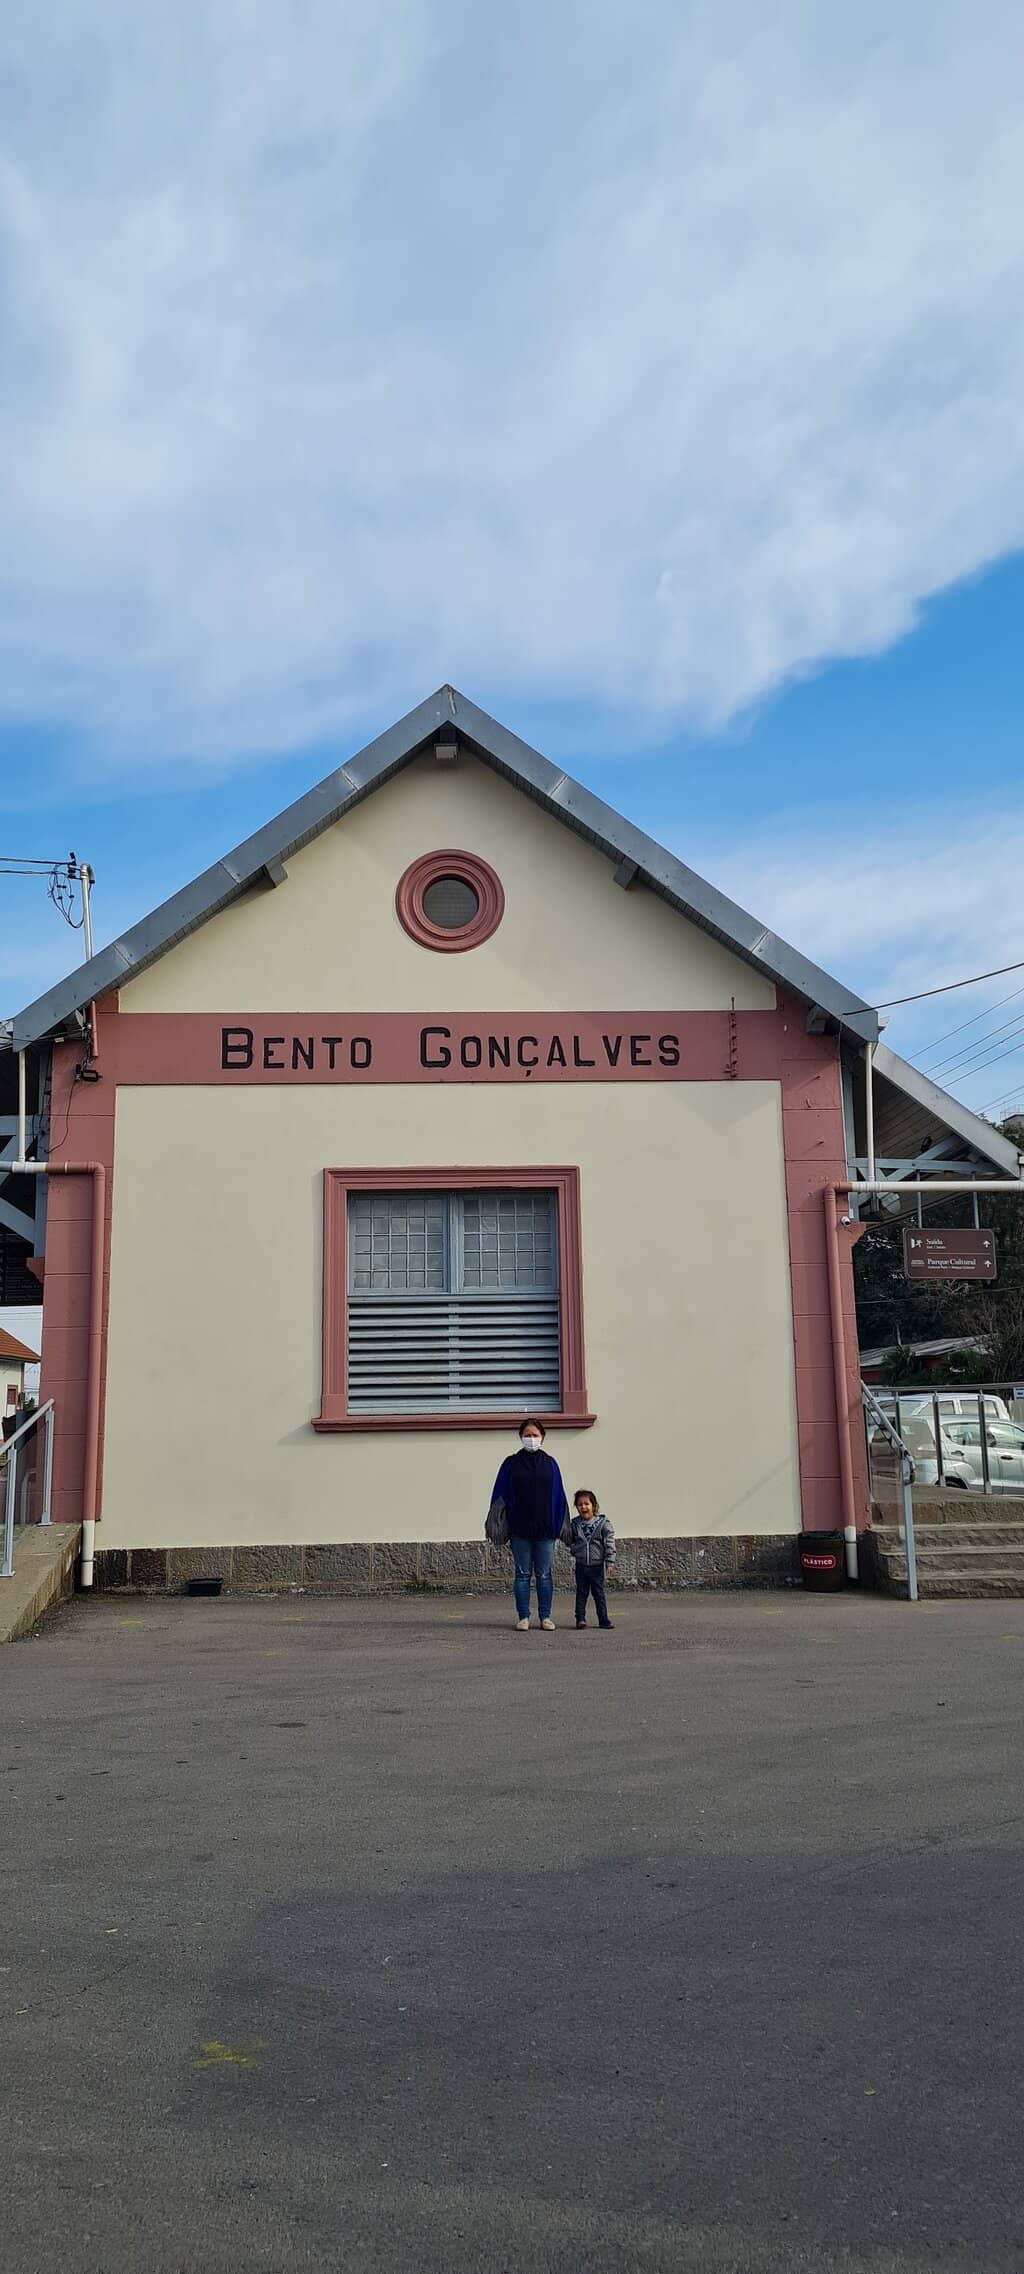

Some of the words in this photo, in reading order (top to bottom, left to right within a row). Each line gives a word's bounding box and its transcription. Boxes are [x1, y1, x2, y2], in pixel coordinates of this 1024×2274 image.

[221, 1027, 372, 1070] BENTO
[419, 1026, 681, 1077] GONÇALVES
[927, 1258, 950, 1267] Parque
